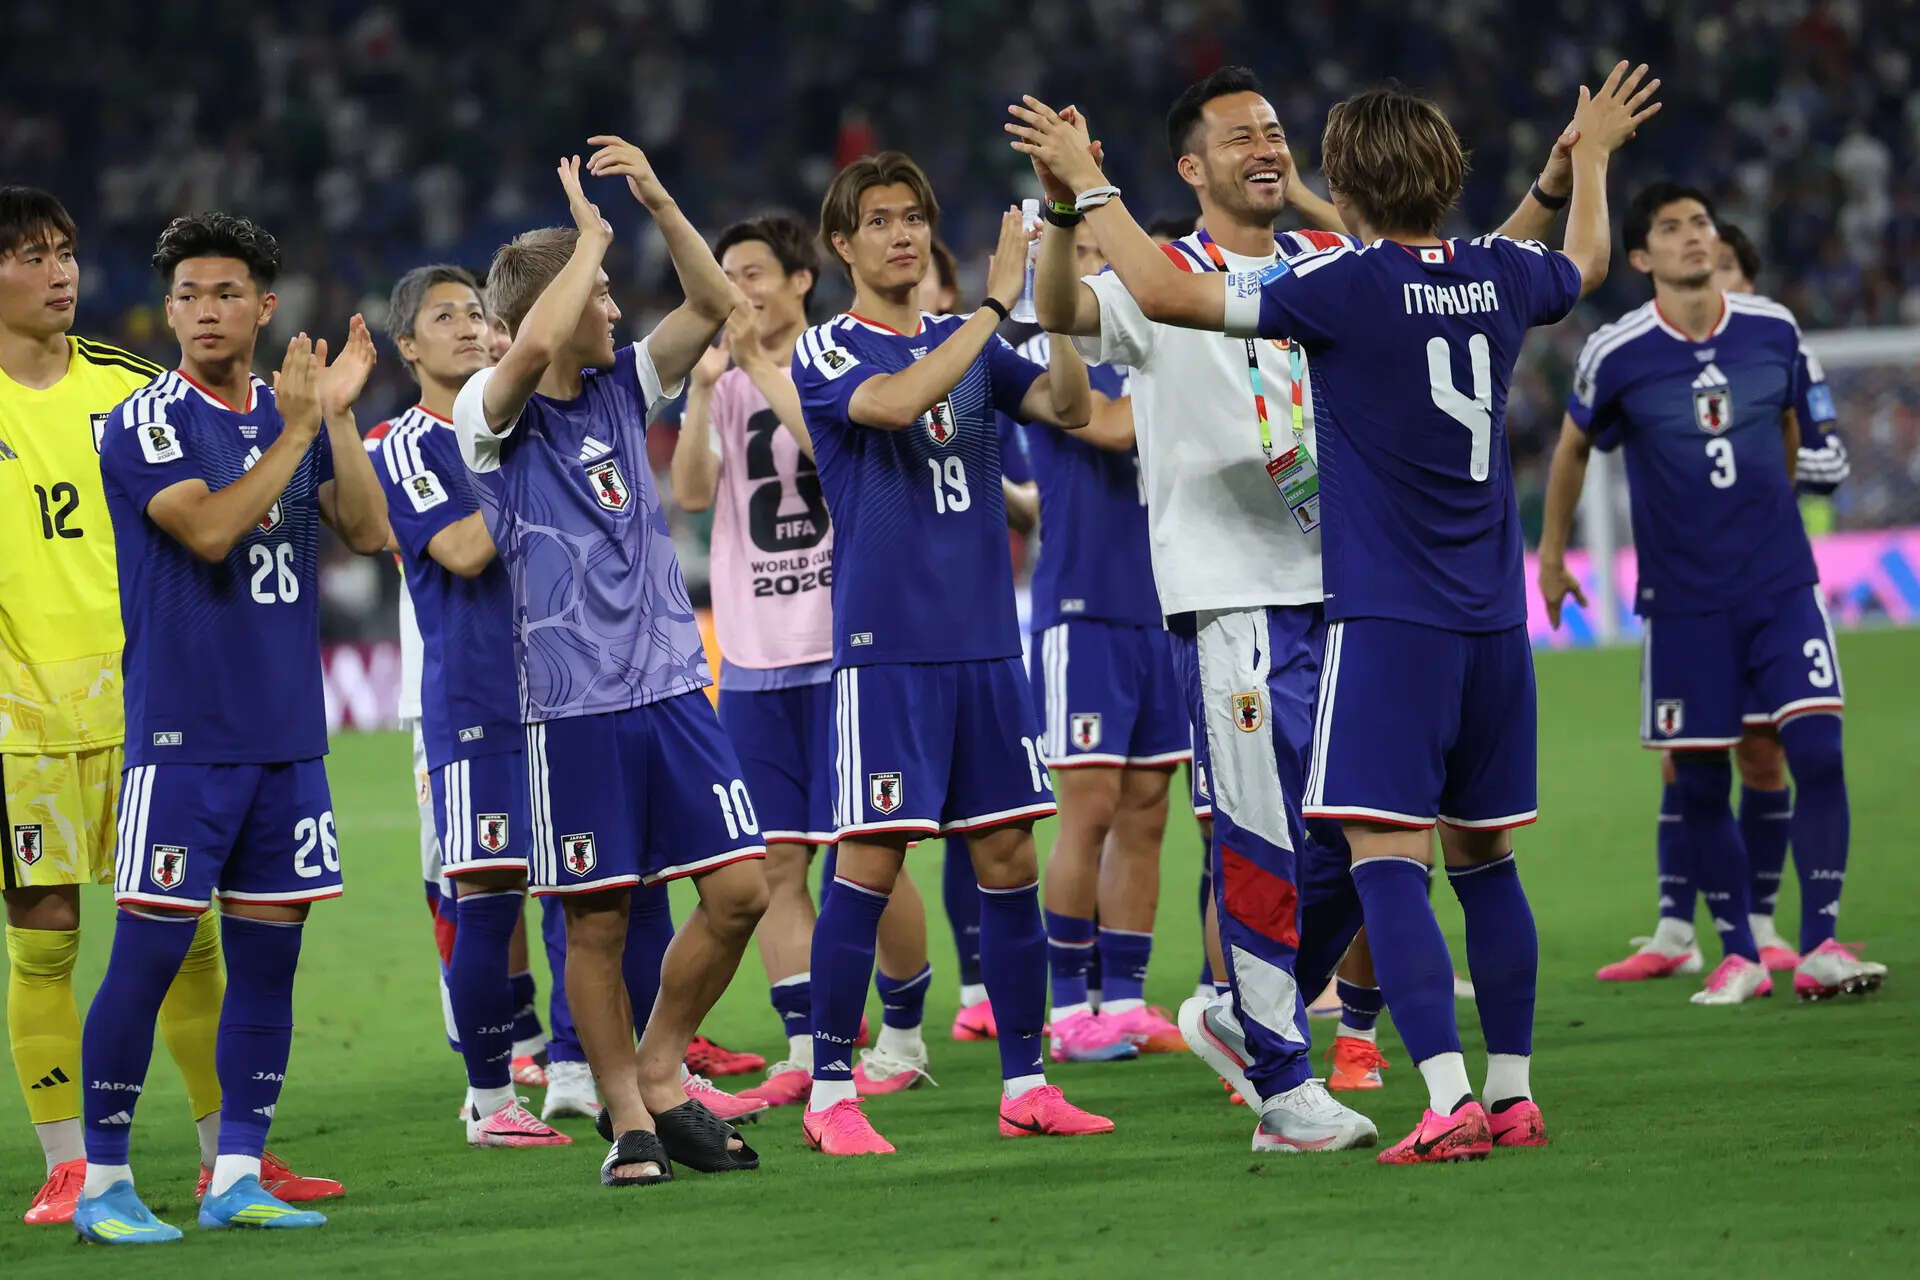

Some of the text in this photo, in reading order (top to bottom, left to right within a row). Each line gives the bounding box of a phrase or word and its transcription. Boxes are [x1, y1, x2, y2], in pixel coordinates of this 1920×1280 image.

[1403, 280, 1499, 315] ITAKURA
[1426, 333, 1492, 482] 4
[928, 456, 971, 514] 19
[1705, 437, 1737, 488] 3
[34, 482, 84, 539] 12
[776, 518, 817, 540] FIFA
[250, 543, 300, 604] 26
[751, 557, 809, 573] WORLD
[753, 565, 832, 597] 2026
[1803, 638, 1835, 689] 3
[712, 779, 759, 840] 10
[294, 811, 340, 878] 26
[815, 1030, 853, 1044] JAPA
[252, 1071, 284, 1082] JAP
